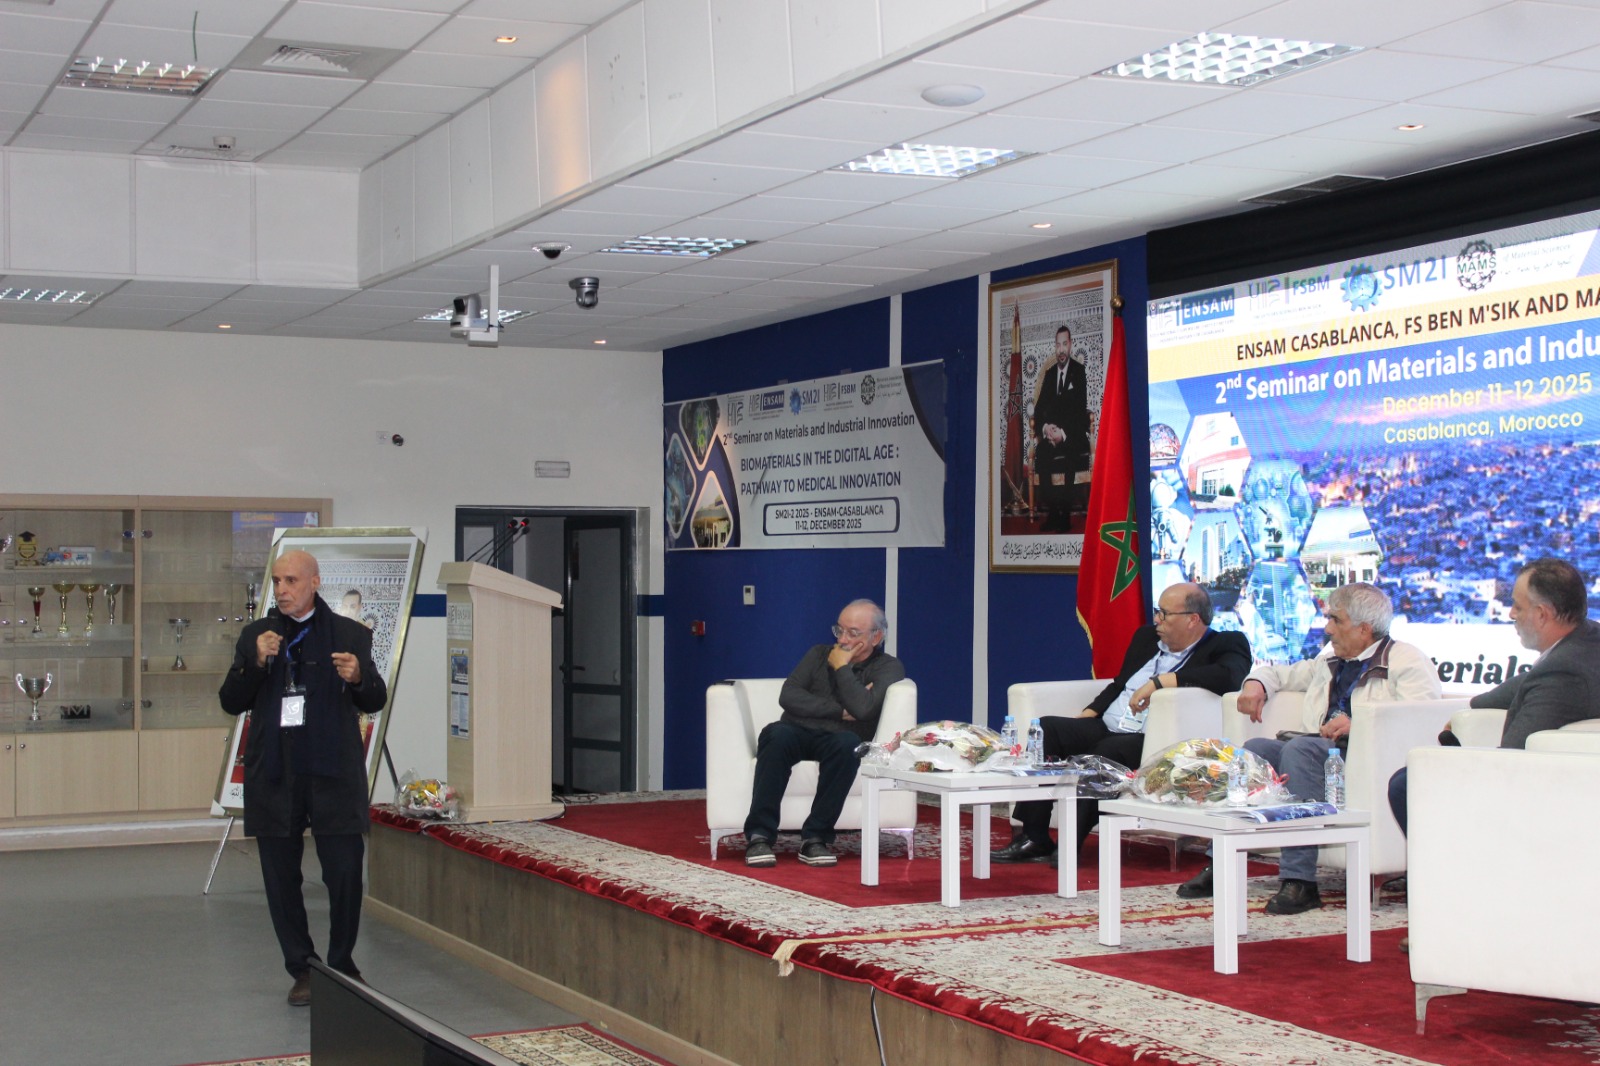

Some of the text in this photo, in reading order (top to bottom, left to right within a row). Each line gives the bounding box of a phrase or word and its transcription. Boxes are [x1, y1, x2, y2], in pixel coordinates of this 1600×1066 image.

[1383, 254, 1448, 291] SM2I
[1456, 256, 1498, 275] MAMS
[1292, 275, 1330, 296] FSBM
[1184, 294, 1234, 319] ENSAM
[1236, 337, 1287, 361] ENSAM
[1290, 320, 1400, 353] CASABLANCA,
[1404, 315, 1423, 336] FS
[1427, 308, 1463, 332] BEN
[1468, 299, 1520, 326] M'SIK
[1524, 292, 1570, 317] AND
[1215, 372, 1243, 405] 2nd
[1246, 370, 1330, 401] Seminar
[1333, 368, 1362, 389] on
[1366, 345, 1478, 386] Materials
[1482, 336, 1533, 371] and
[763, 392, 785, 408] ENSAM
[802, 389, 820, 405] SM2I
[1383, 371, 1594, 415] December 11-12 2025
[733, 430, 762, 445] Seminar
[763, 430, 773, 442] on
[774, 424, 809, 441] Materials
[810, 422, 825, 436] and
[827, 416, 866, 434] Industrial
[867, 411, 915, 430] Innovation
[1384, 411, 1584, 445] Casablanca, Morocco
[741, 453, 801, 471] BIOMATERIALS
[803, 453, 812, 466] IN
[815, 451, 832, 465] THE
[834, 447, 871, 464] DIGITAL
[873, 444, 894, 459] AGE
[741, 471, 901, 495] PATHWAY TO MEDICAL INNOVATION
[795, 507, 809, 518] 2025
[814, 504, 884, 518] ENSAM-CASABLANCA
[810, 519, 846, 531] DECEMBER
[846, 518, 862, 529] 2025
[1430, 653, 1534, 685] erial
